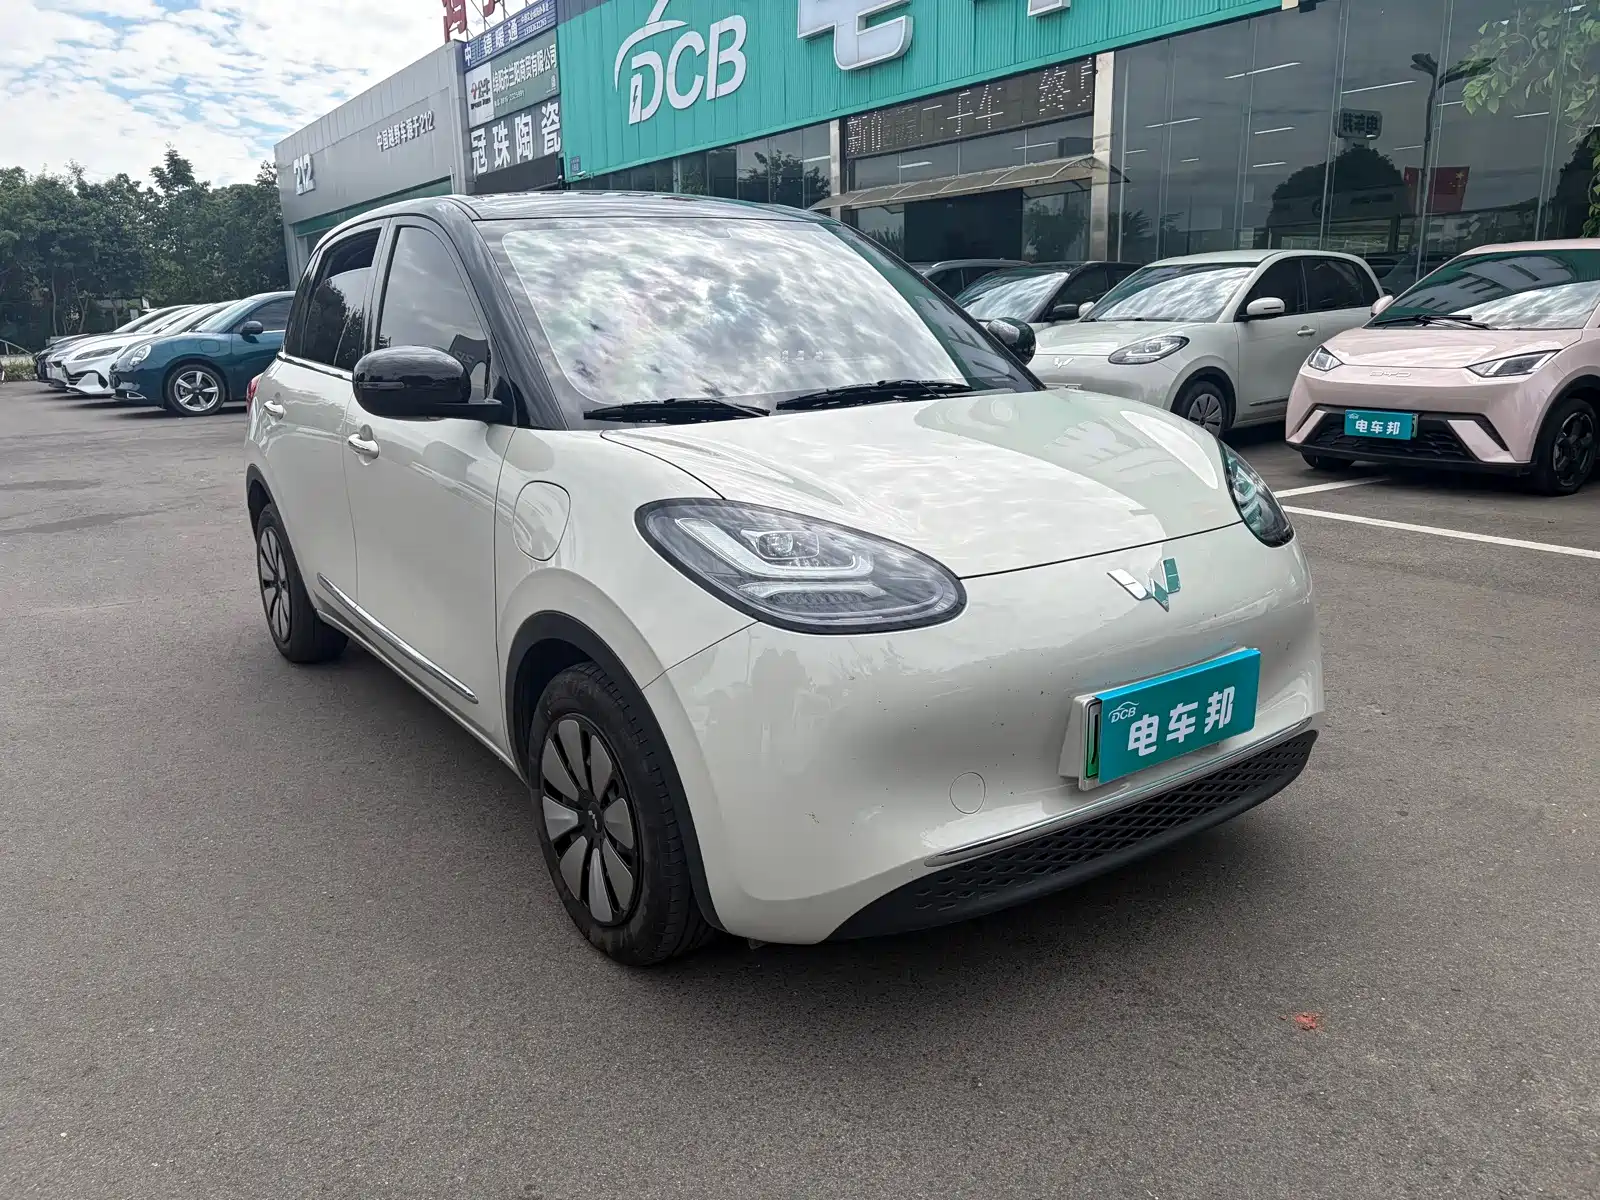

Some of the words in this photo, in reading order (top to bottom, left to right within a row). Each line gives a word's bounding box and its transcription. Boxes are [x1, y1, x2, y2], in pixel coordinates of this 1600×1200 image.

[626, 14, 748, 125] DCB
[470, 102, 561, 176] 冠珠陶瓷
[293, 153, 315, 195] 212
[1355, 419, 1401, 435] 电车邦
[1111, 705, 1136, 723] DCB
[1128, 686, 1235, 757] 电车邦
